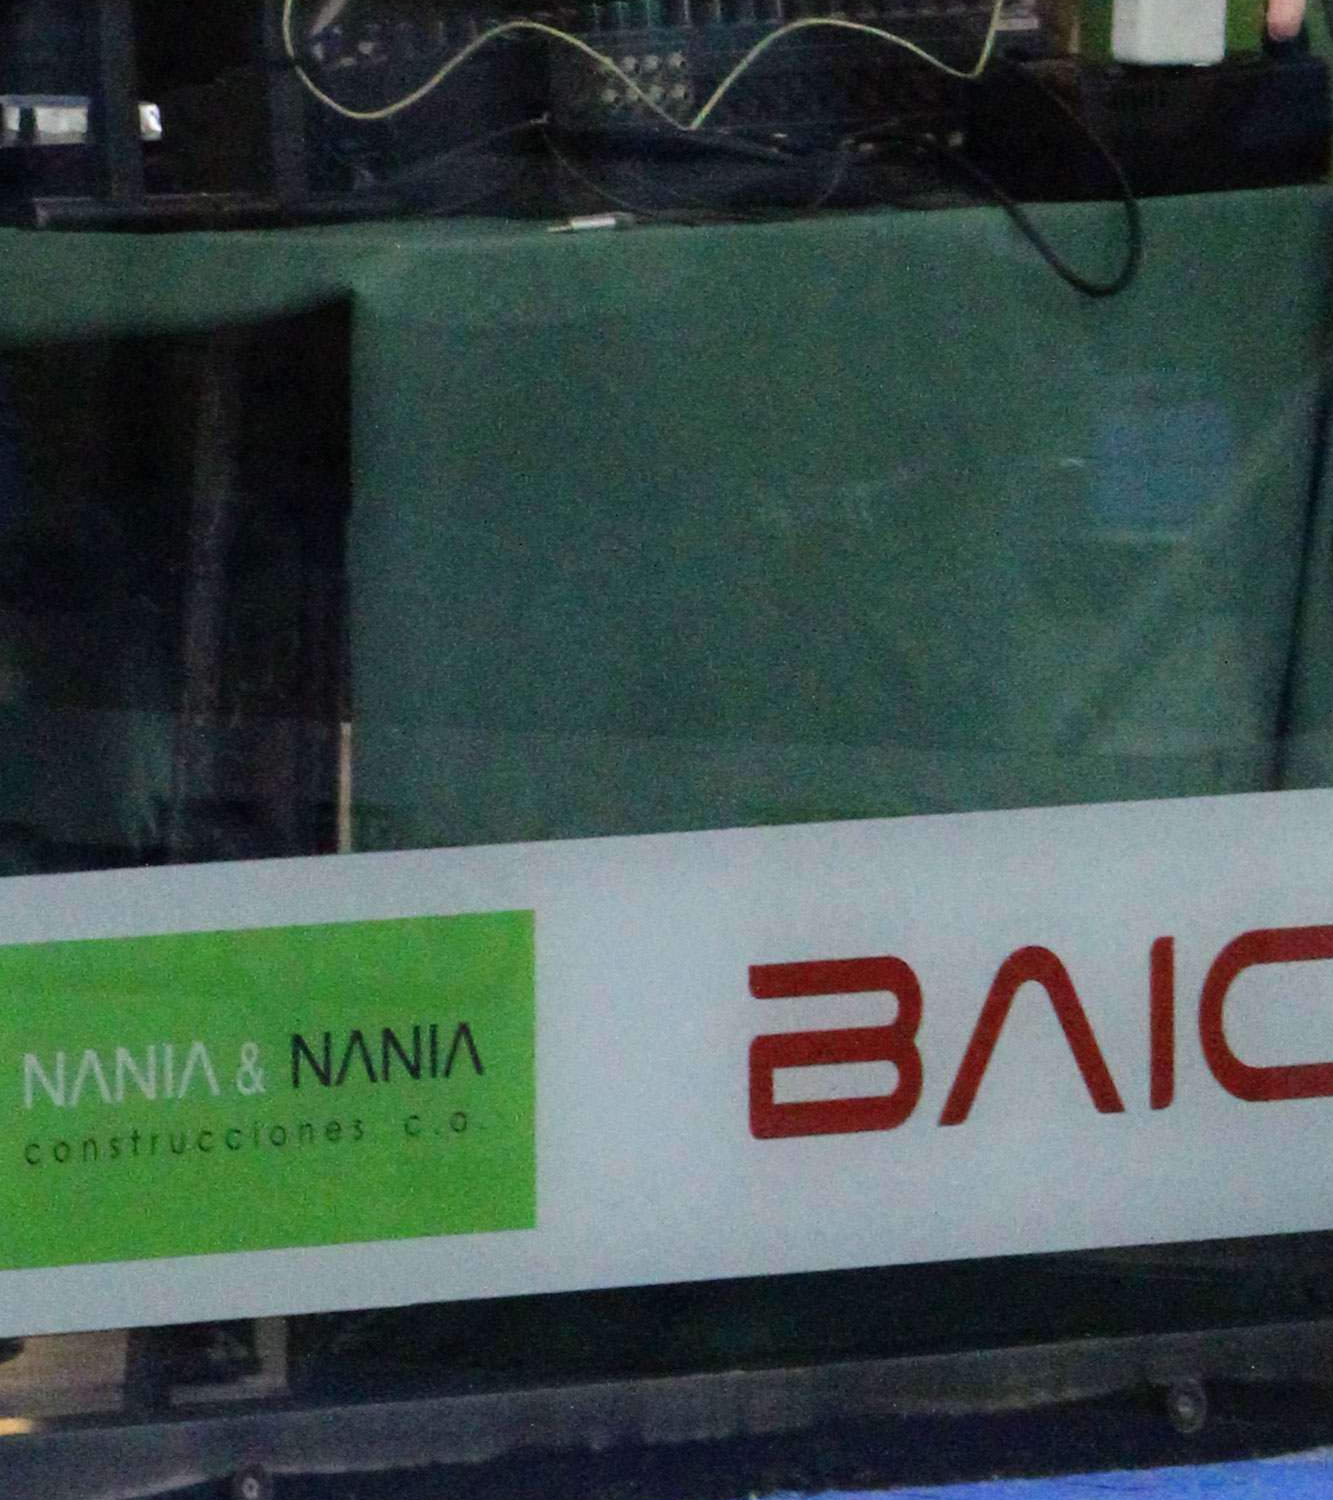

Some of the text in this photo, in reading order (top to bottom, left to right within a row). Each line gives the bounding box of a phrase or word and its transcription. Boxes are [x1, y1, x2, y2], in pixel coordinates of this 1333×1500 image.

[24, 1022, 485, 1108] NANIA & NANIA
[25, 1116, 365, 1165] construcciones
